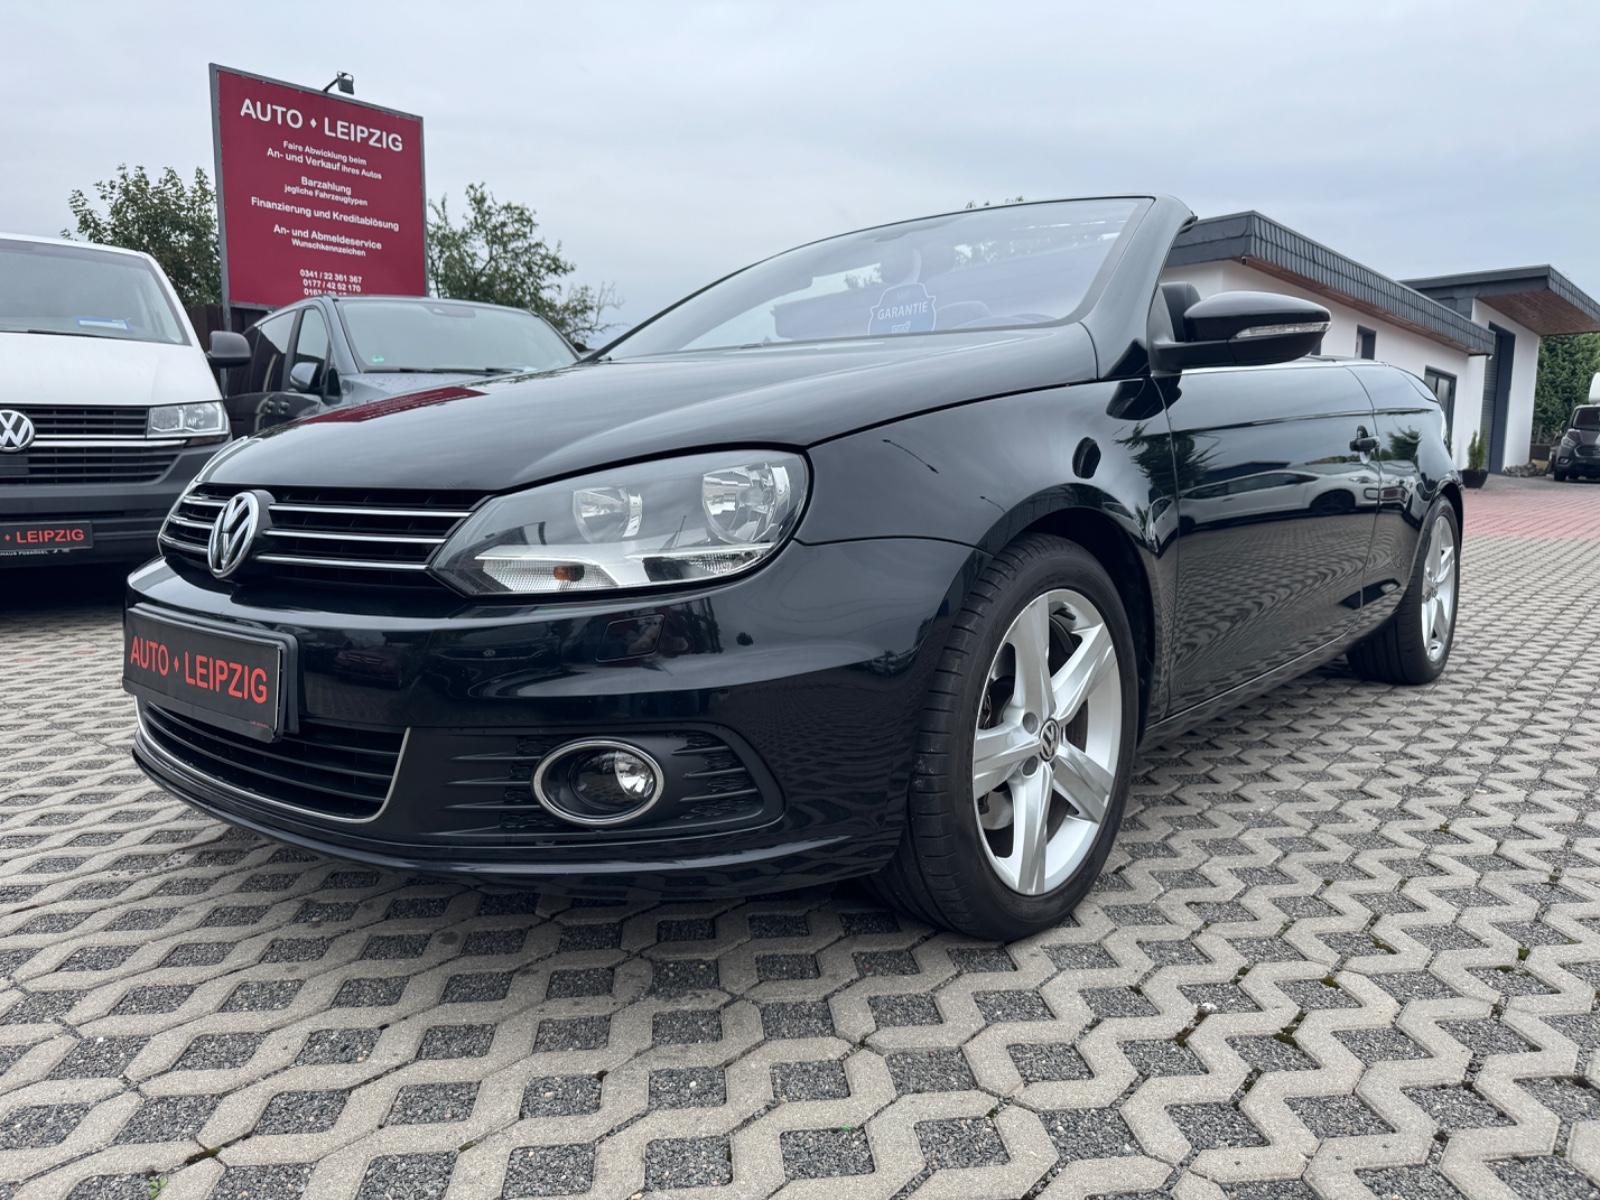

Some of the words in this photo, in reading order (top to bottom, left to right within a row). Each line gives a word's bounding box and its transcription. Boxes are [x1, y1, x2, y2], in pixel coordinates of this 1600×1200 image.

[240, 98, 303, 129] AUTO
[324, 117, 403, 152] LEIPZIG
[267, 147, 284, 158] An-
[285, 153, 303, 163] und
[305, 155, 341, 170] Verkauf
[361, 169, 382, 180] Autos
[283, 140, 303, 152] Faire
[304, 145, 347, 163] Abwicklung
[349, 155, 367, 165] beim
[284, 184, 314, 197] jegliche
[315, 190, 368, 206] Fahrzeugtypen
[301, 176, 352, 195] Barzahlung
[251, 196, 312, 218] Finanzierung
[313, 208, 331, 219] und
[332, 211, 399, 232] Kreditablösung
[273, 224, 290, 235] An-
[291, 228, 309, 238] und
[311, 231, 382, 250] Abmeldeservice
[291, 238, 366, 257] Wunschkennzeichen
[299, 268, 318, 278] 0341
[303, 278, 321, 288] 0177
[877, 301, 929, 320] GARANTIE
[16, 528, 85, 544] LEIPZIG
[130, 635, 170, 677] AUTO
[184, 651, 268, 704] LEIPZIG
